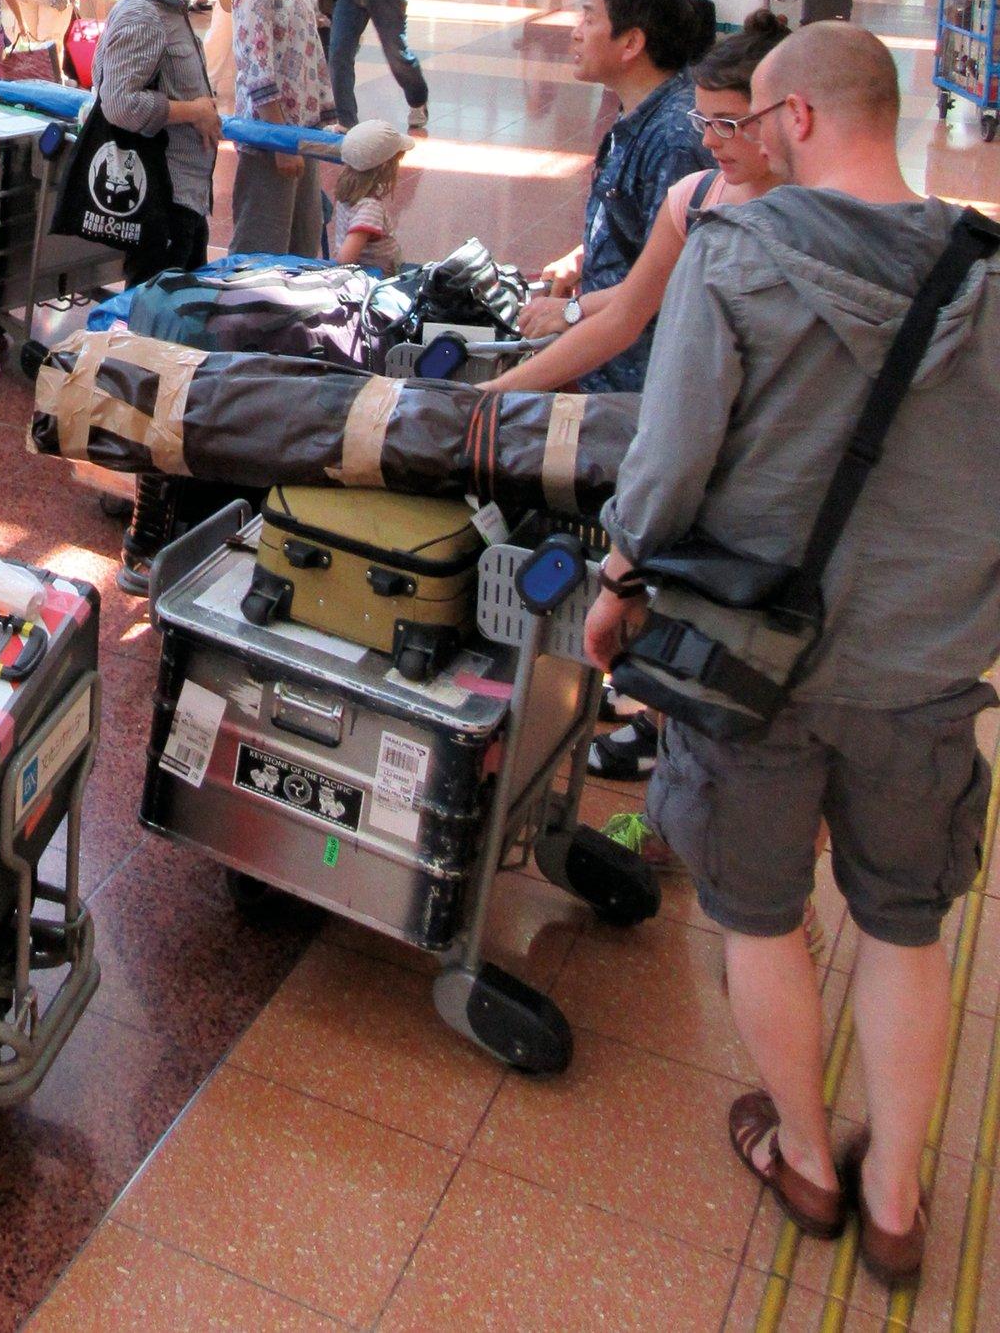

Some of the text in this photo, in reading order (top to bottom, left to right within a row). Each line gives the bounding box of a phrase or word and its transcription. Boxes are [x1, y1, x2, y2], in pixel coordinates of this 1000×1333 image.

[104, 216, 121, 236] &
[249, 749, 353, 795] KEYSTONE OF THE PACIFIC
